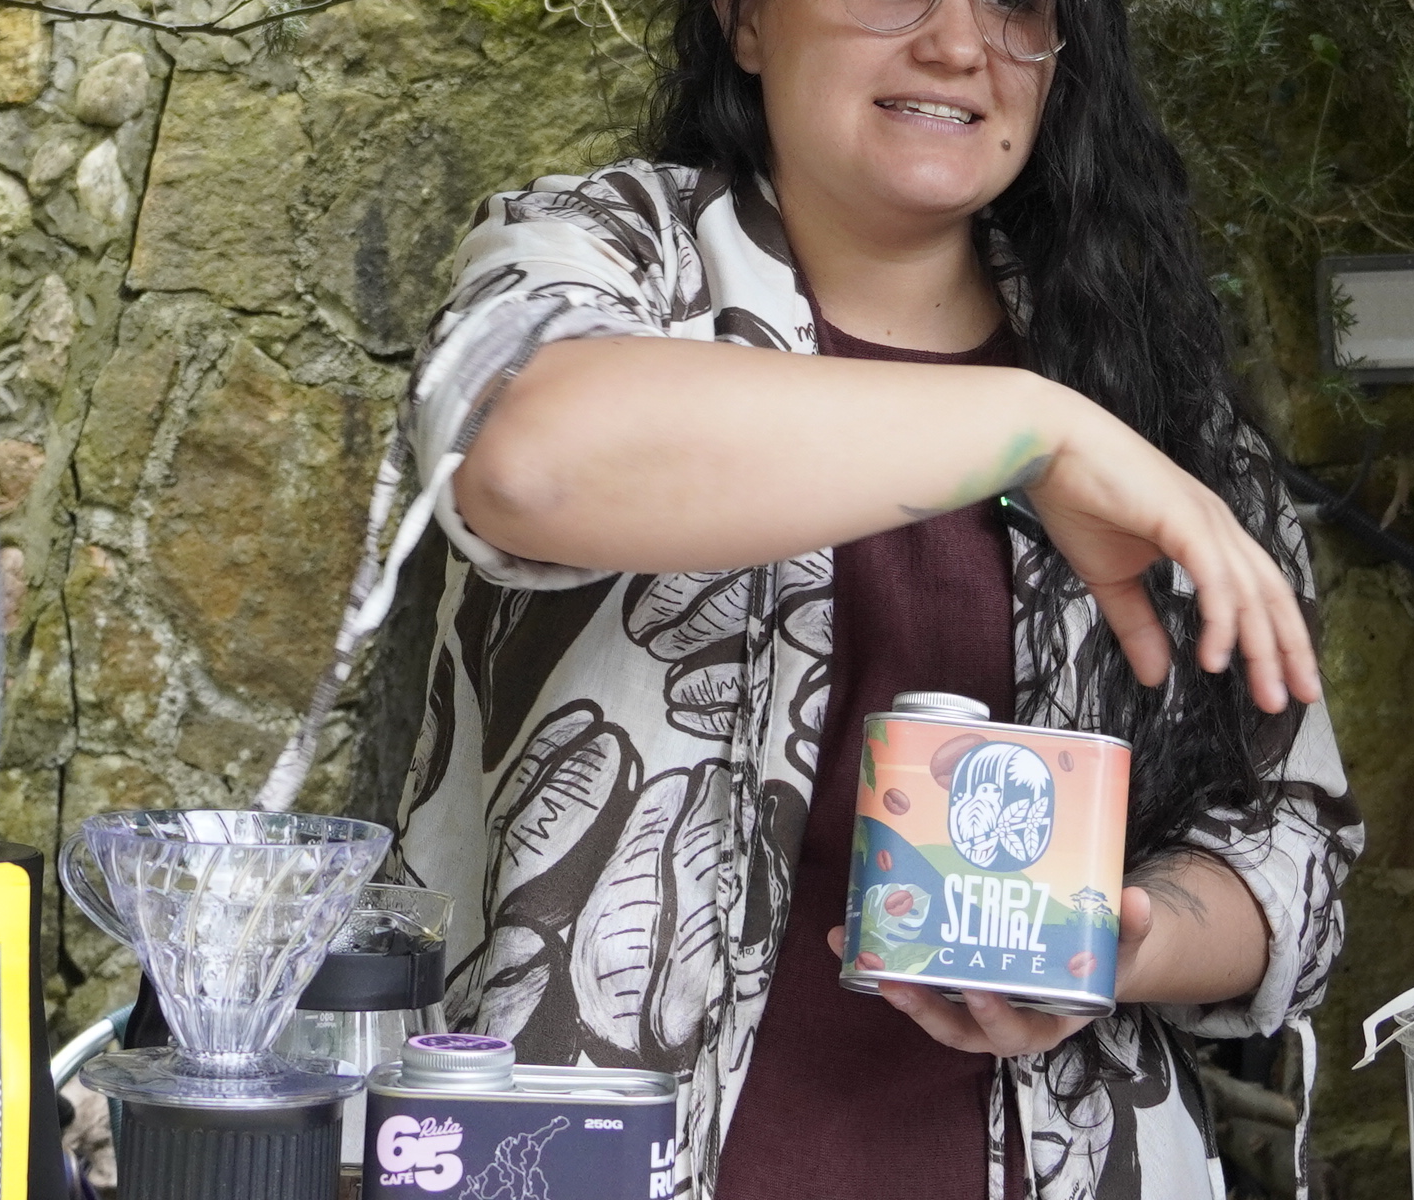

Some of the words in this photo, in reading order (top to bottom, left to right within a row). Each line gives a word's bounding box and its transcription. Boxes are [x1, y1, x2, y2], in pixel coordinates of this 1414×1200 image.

[938, 947, 1046, 975] CAFÉ
[419, 1116, 463, 1138] Ruta
[584, 1118, 623, 1130] 250G
[377, 1114, 463, 1192] 65
[380, 1168, 414, 1186] CAFÉ
